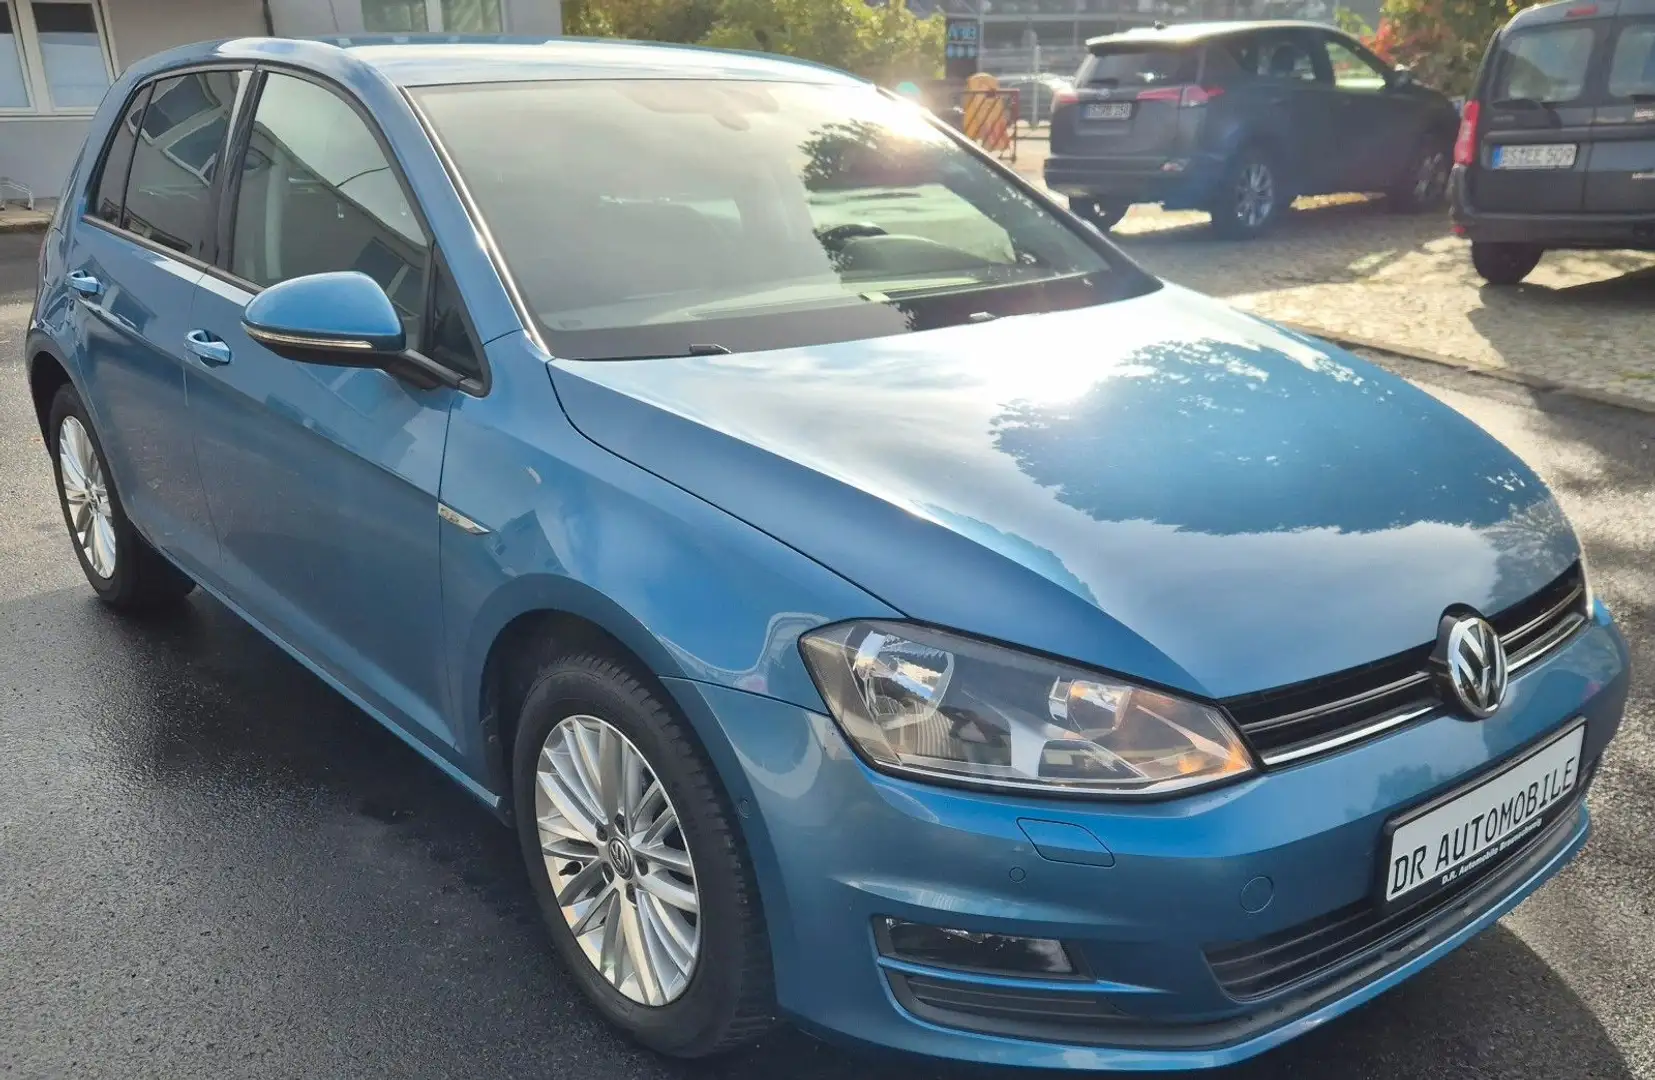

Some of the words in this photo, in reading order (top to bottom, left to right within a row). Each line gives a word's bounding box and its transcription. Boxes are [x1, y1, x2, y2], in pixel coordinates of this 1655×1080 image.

[1391, 845, 1427, 895] DR
[1435, 756, 1576, 872] AUTOMOBILE
[1459, 847, 1499, 875] Automobile
